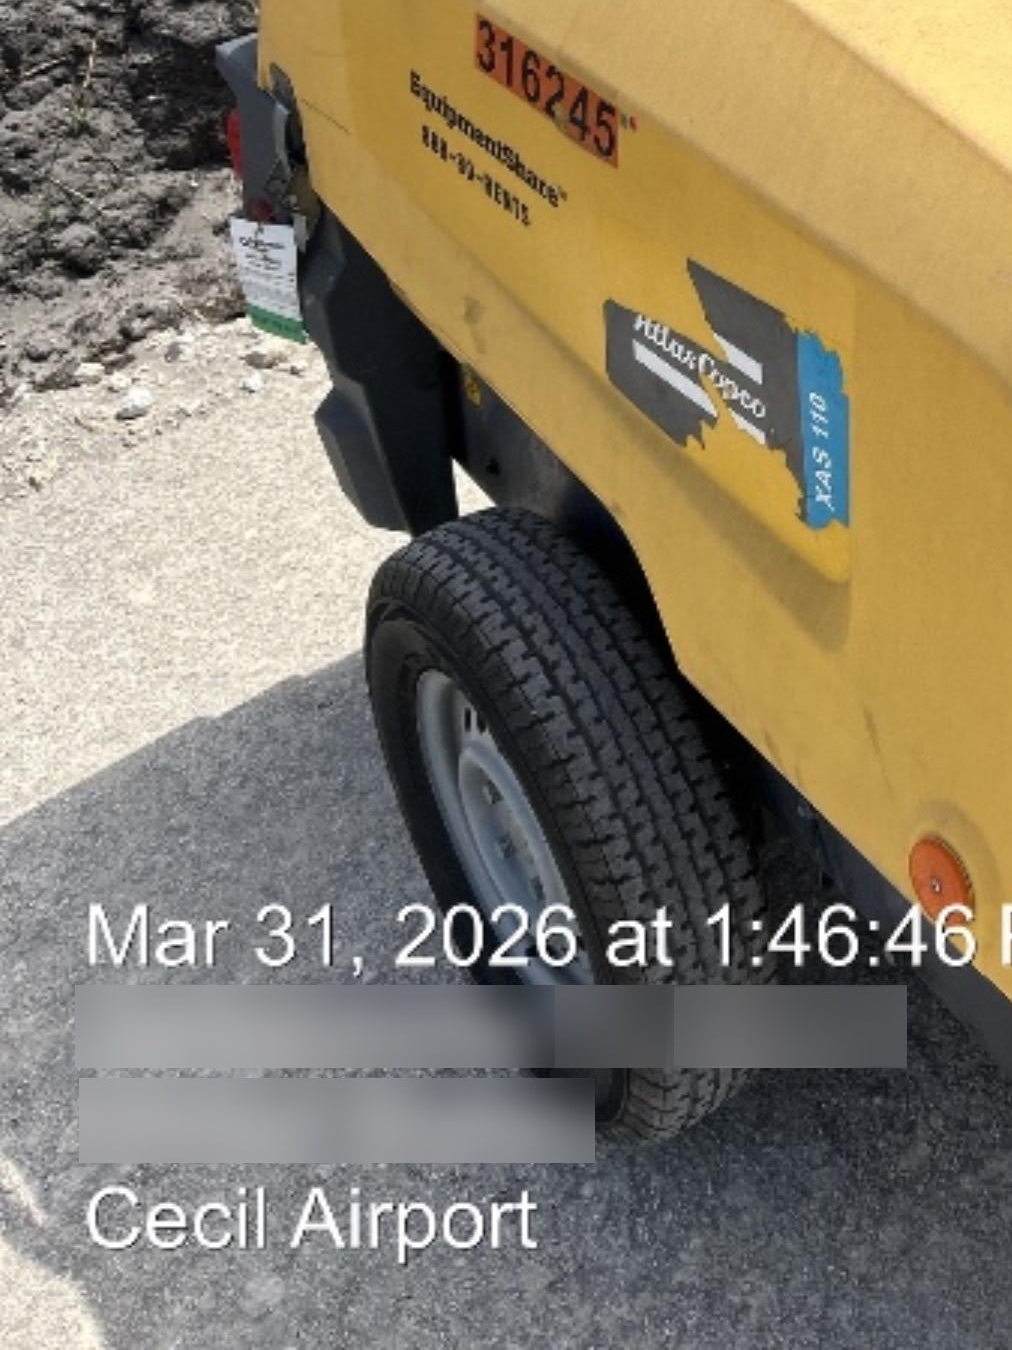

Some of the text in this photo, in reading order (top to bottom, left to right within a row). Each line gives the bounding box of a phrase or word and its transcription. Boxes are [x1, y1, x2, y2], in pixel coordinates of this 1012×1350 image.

[477, 18, 617, 159] 316245
[807, 391, 836, 513] XAS 110
